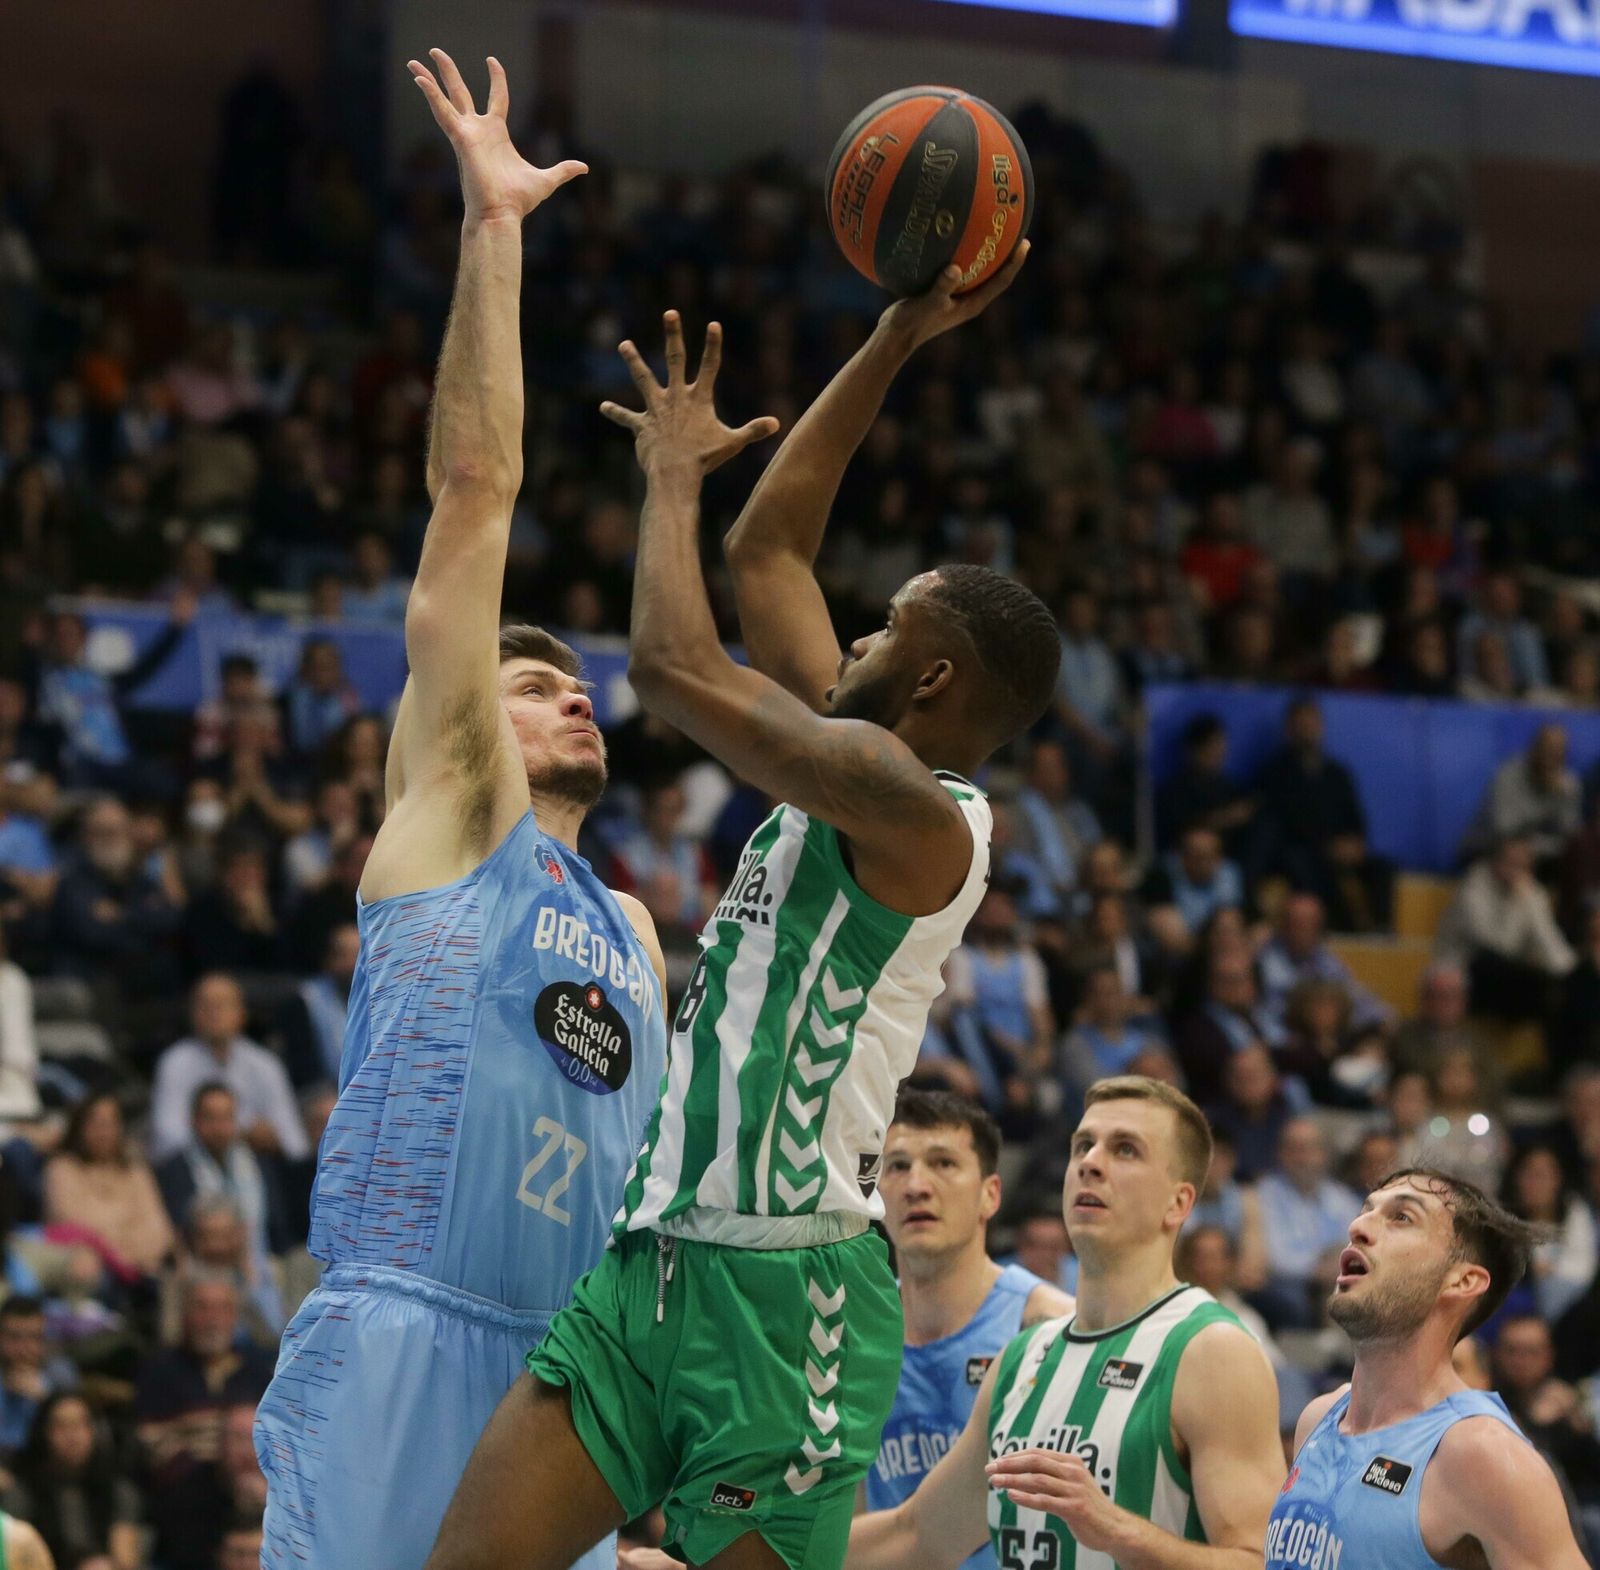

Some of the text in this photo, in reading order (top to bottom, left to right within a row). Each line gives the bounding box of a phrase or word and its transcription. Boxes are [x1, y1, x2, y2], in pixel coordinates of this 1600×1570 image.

[992, 153, 1011, 205] liga
[554, 993, 622, 1055] Estrella
[554, 1018, 610, 1077] Galicia
[515, 1115, 587, 1227] 22
[991, 1428, 1111, 1479] Slla.
